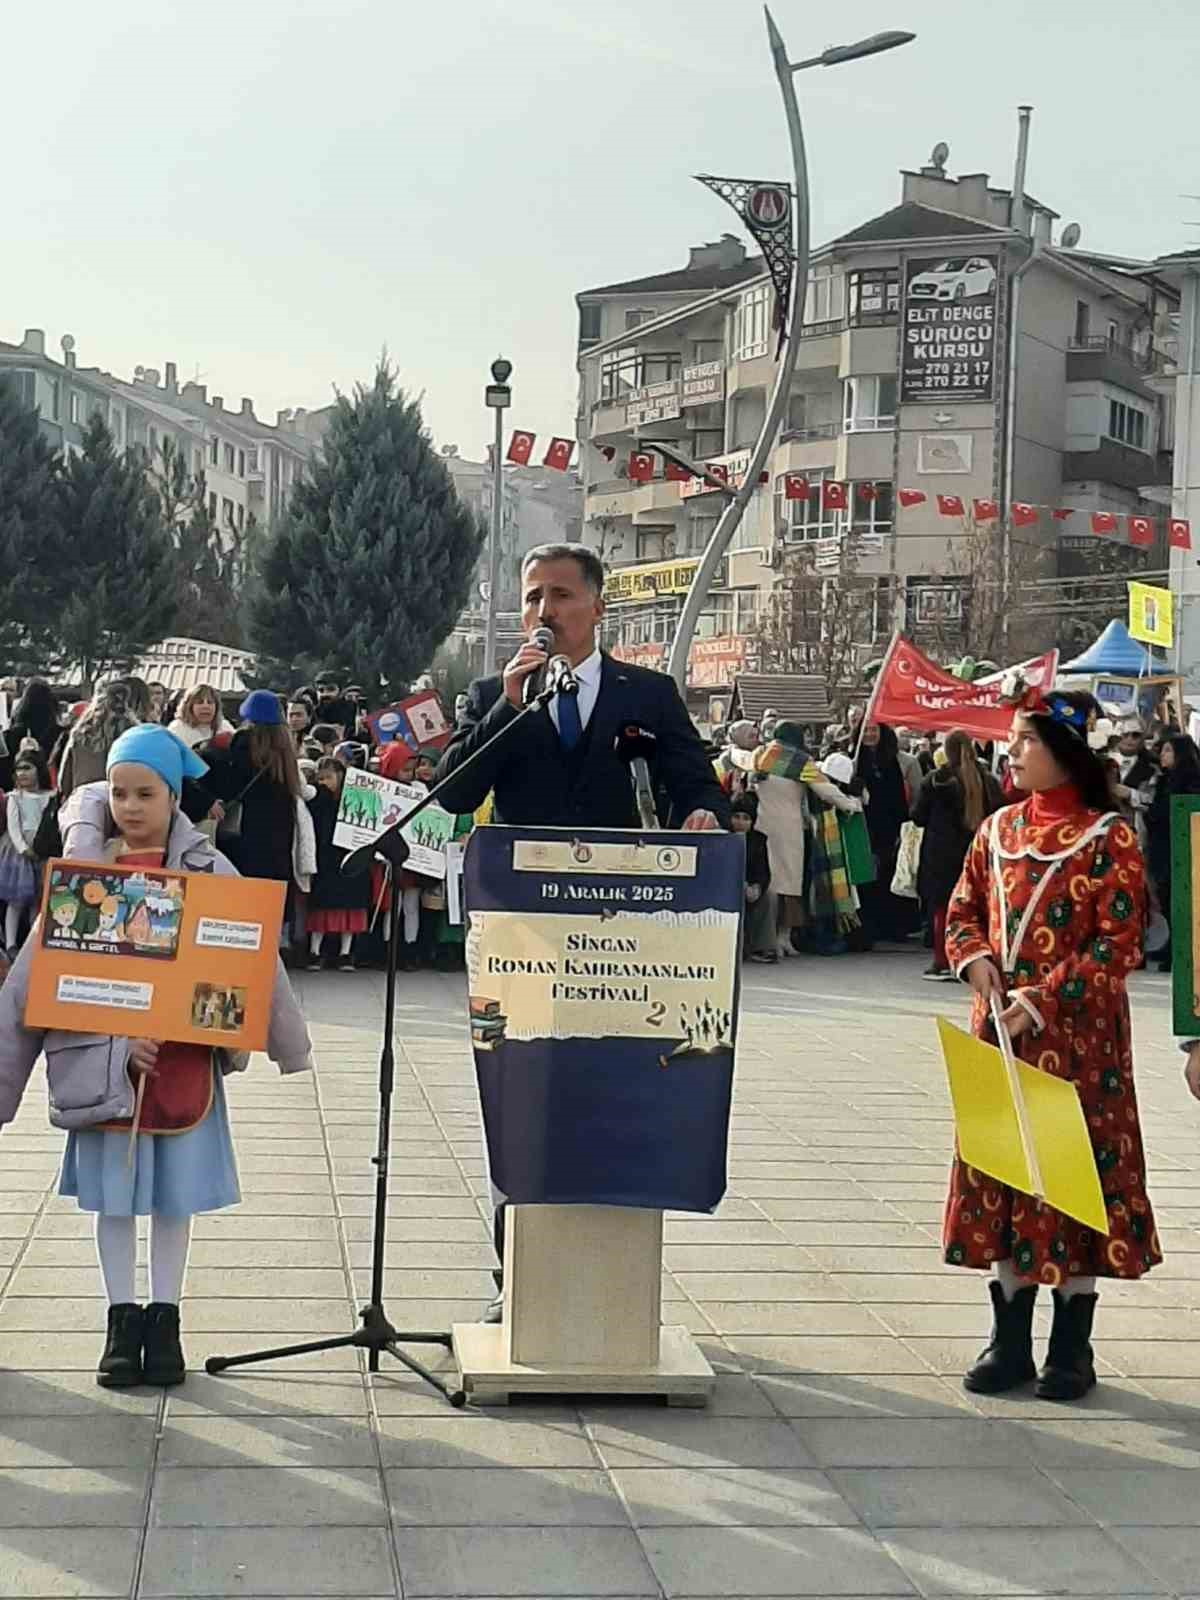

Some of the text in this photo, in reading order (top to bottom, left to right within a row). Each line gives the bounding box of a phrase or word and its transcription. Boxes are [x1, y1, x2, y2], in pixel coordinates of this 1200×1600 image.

[943, 306, 993, 321] DENGE
[907, 323, 993, 343] SÜRÜCÜ
[913, 342, 984, 359] KURSU
[975, 361, 990, 373] 17
[925, 376, 949, 387] 270
[952, 375, 969, 386] 22
[974, 374, 990, 386] 17
[541, 883, 674, 901] 19 ARALIK 2025
[566, 933, 638, 952] SİNCAN
[487, 956, 716, 979] ROMAN KAHRAMANLARI
[551, 982, 649, 1002] FESTİVALİ
[645, 1001, 667, 1026] 2
